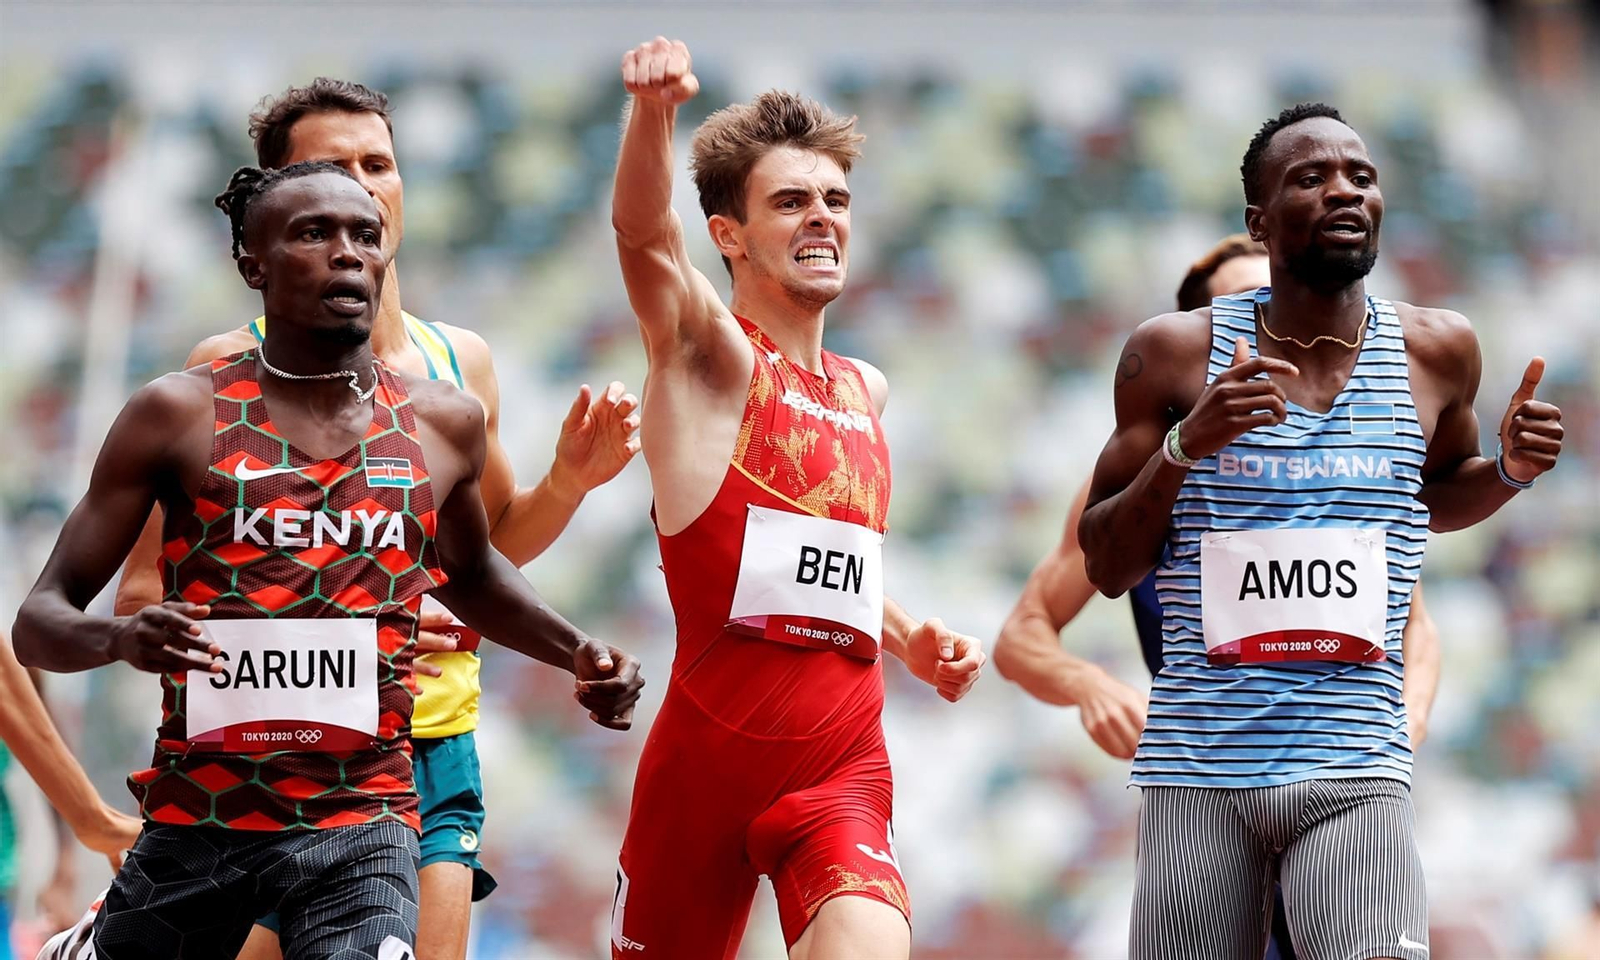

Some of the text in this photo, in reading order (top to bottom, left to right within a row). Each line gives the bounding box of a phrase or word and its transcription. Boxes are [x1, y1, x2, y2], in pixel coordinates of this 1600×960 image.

[1218, 452, 1393, 479] BOTSWANA
[233, 507, 406, 551] KENYA
[795, 545, 864, 595] BEN
[1238, 559, 1358, 601] AMOS
[785, 624, 830, 641] TOKYO 2020
[1259, 641, 1311, 652] TOKYO 2020
[209, 649, 356, 690] SARUNI
[241, 731, 292, 742] TOKYO 2020
